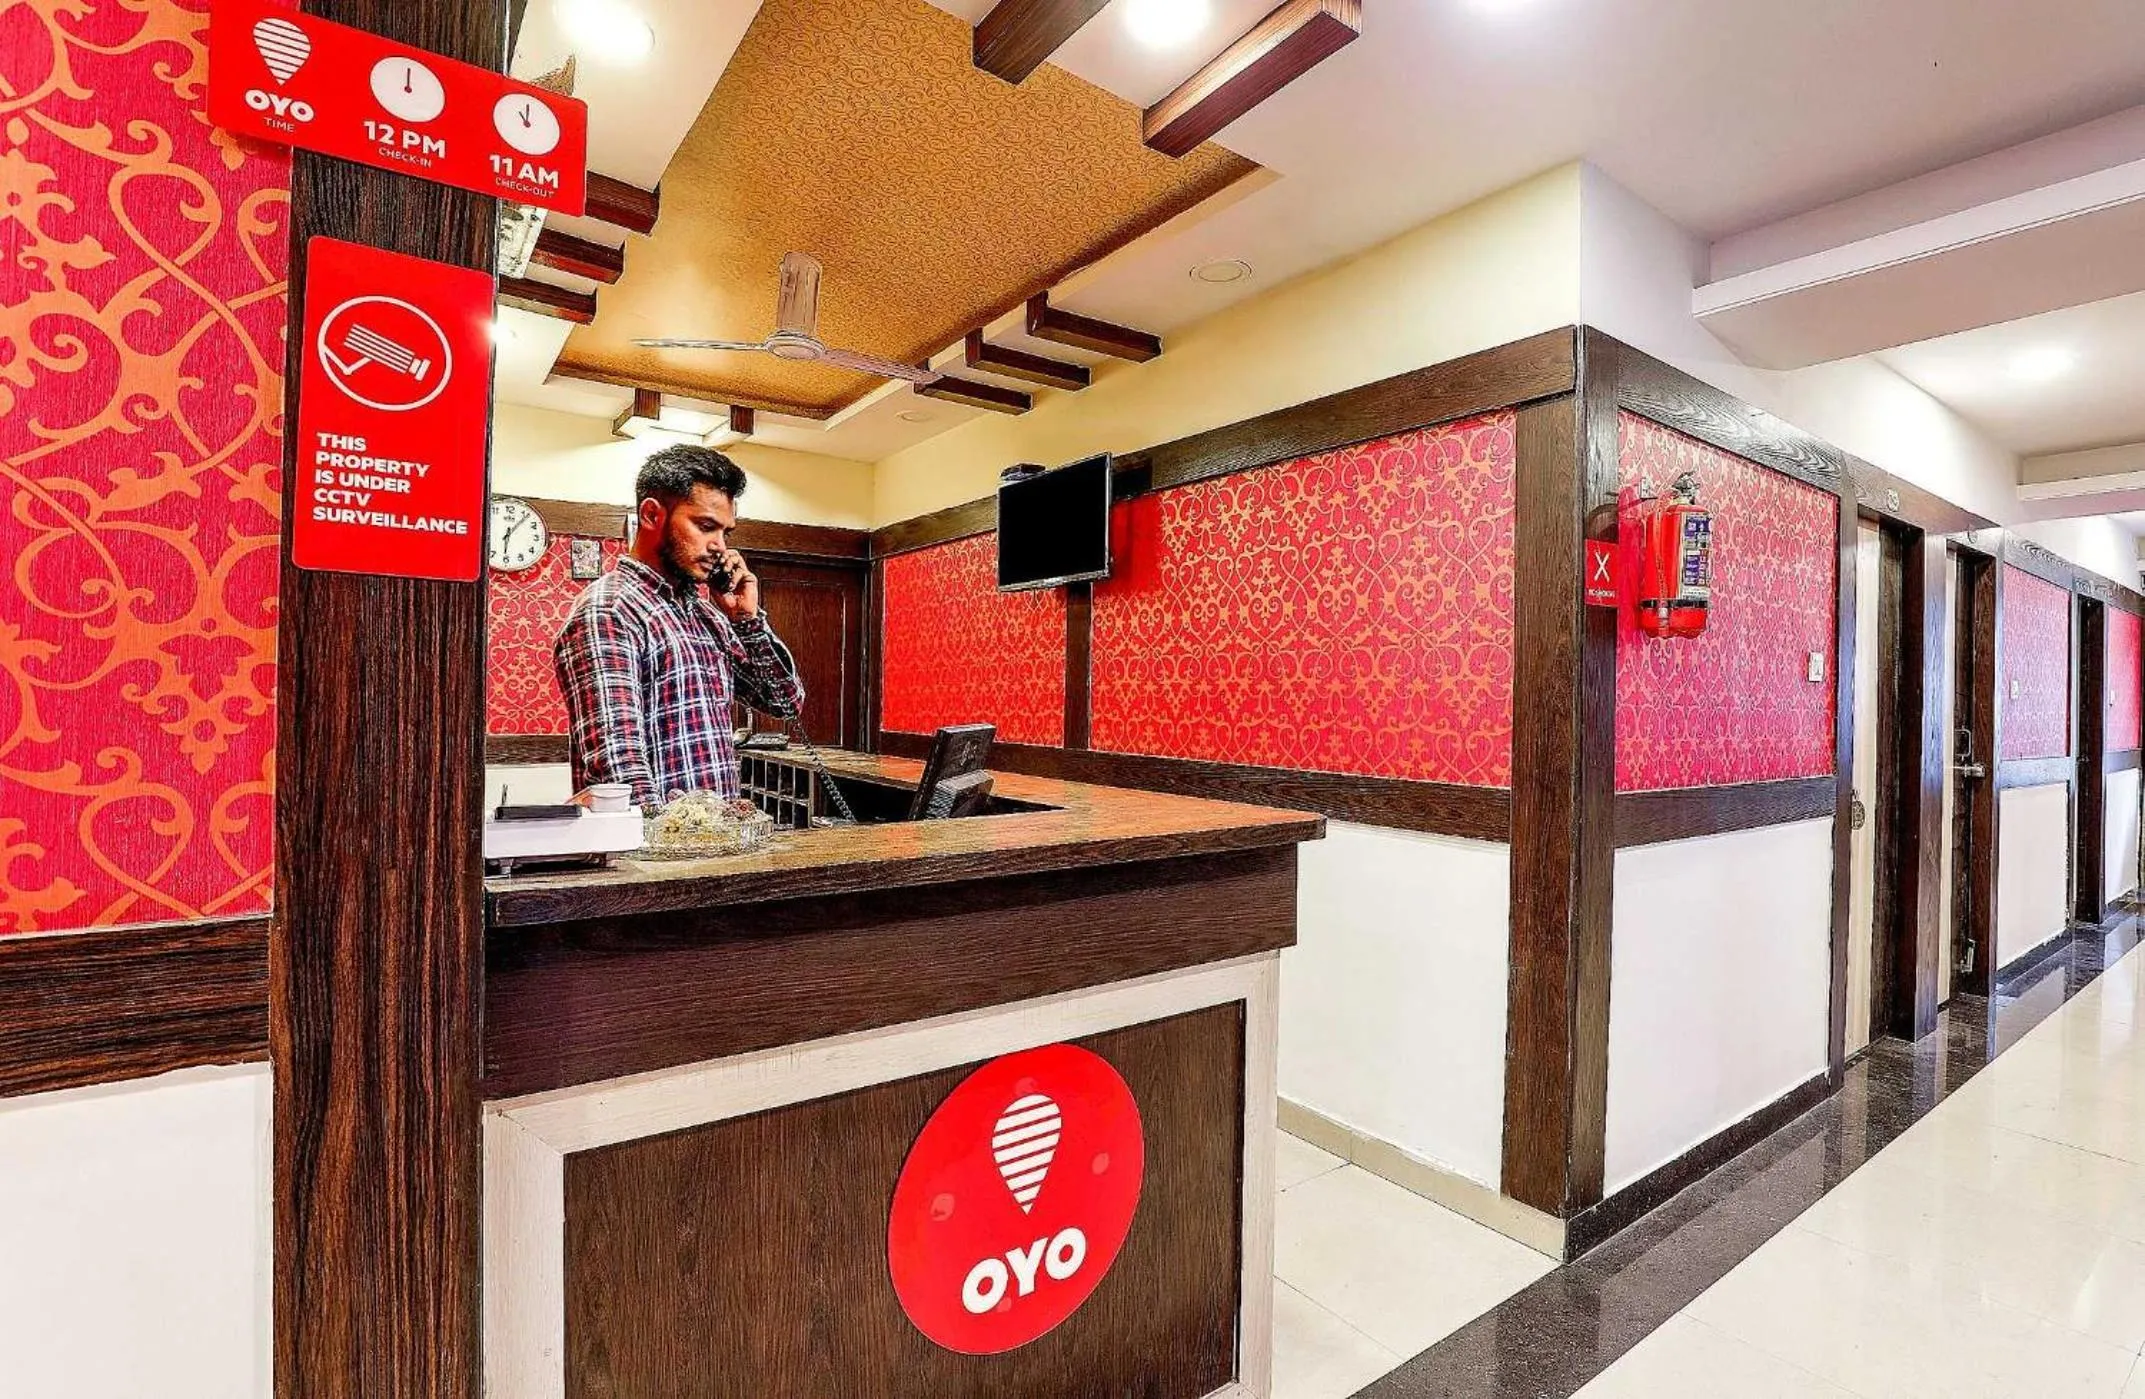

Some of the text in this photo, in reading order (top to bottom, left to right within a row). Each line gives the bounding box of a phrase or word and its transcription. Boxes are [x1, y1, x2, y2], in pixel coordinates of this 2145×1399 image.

[245, 89, 315, 123] OYO
[263, 117, 295, 133] TIME
[364, 121, 446, 159] 12 PM
[378, 147, 432, 168] CHECK-IN
[490, 155, 559, 189] 11 AM
[495, 178, 555, 198] CHECK-OUT
[316, 432, 367, 452] THIS
[315, 451, 431, 478] PROPERTY
[314, 469, 412, 494] IS UNDER
[313, 488, 372, 506] CCTV
[505, 505, 515, 514] 12
[312, 506, 469, 535] SURVEILLANCE
[530, 522, 537, 530] 2
[529, 546, 534, 554] 4
[961, 1226, 1088, 1314] OYO
